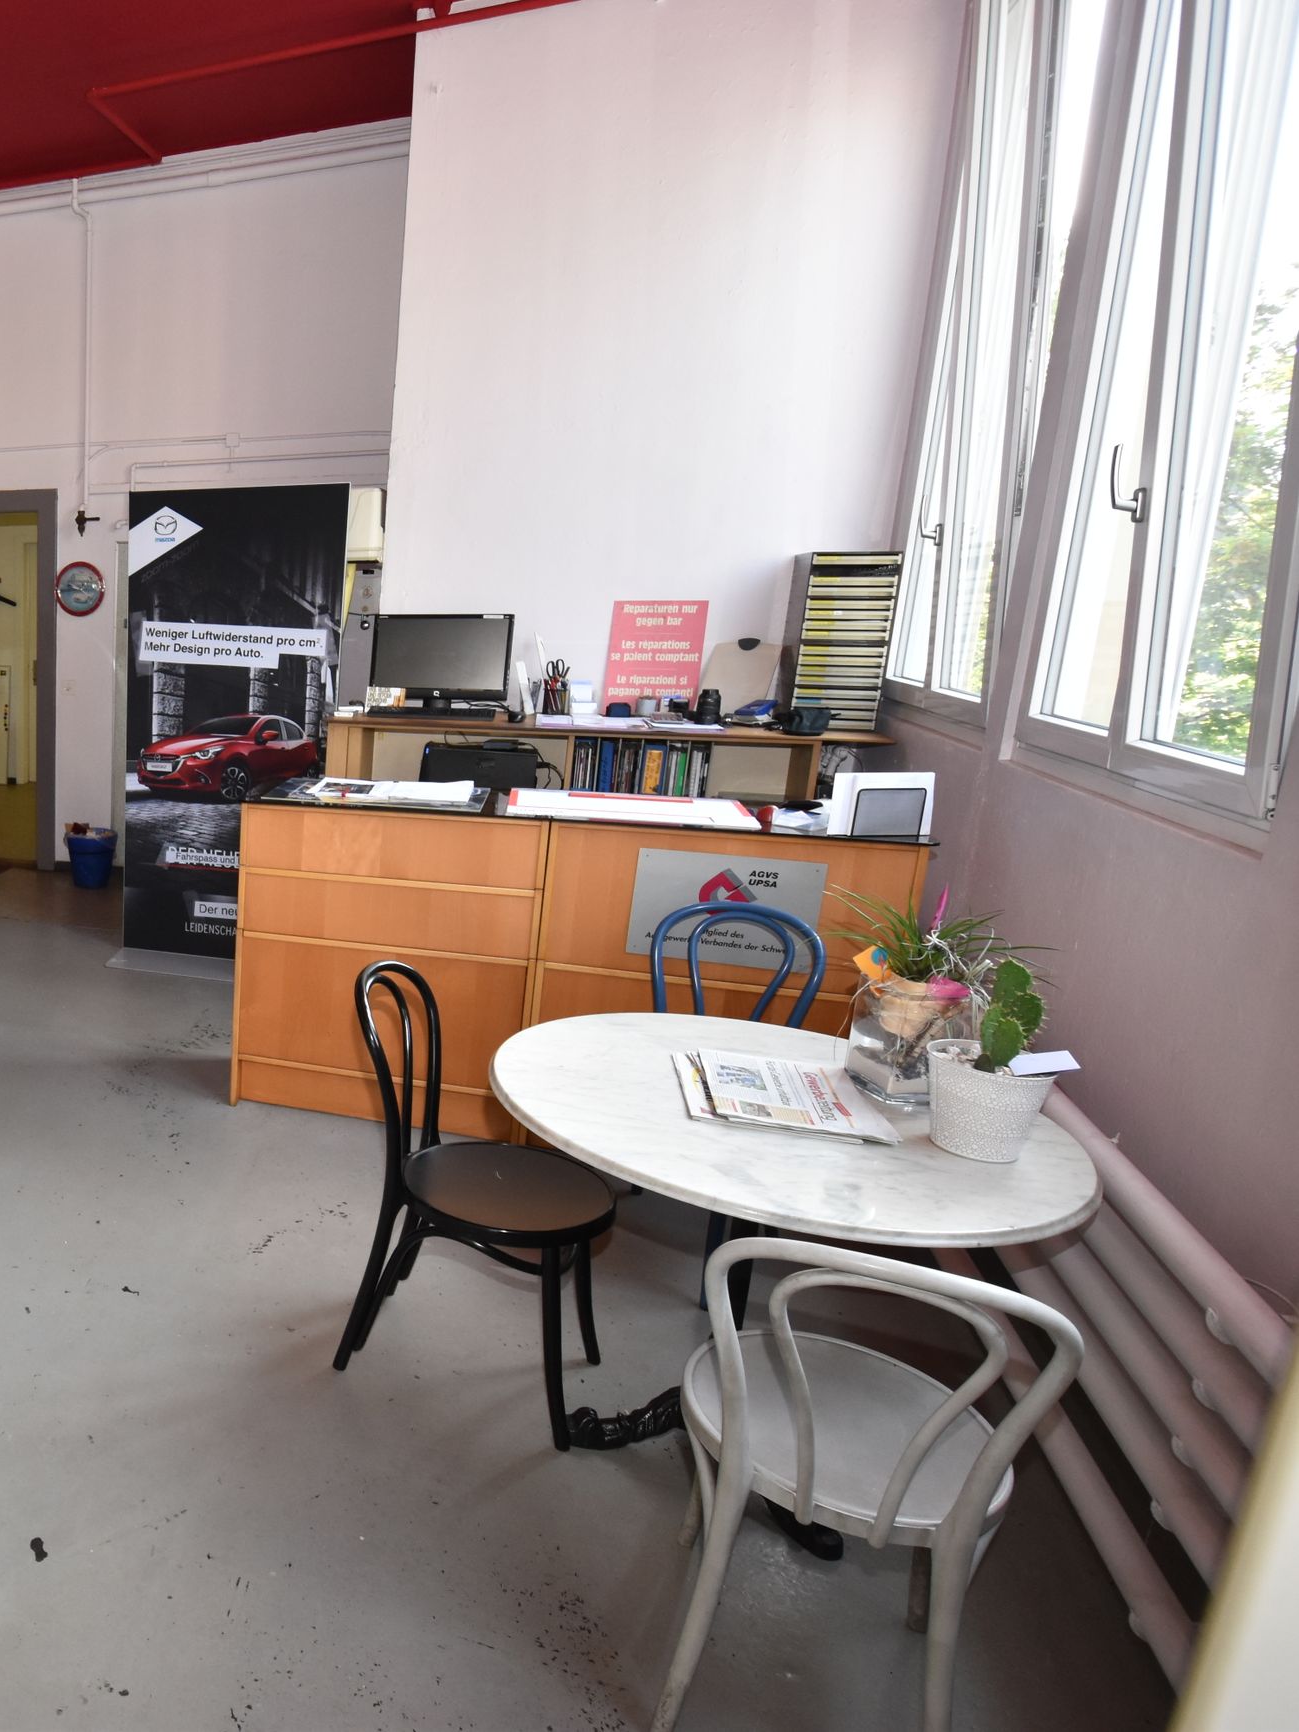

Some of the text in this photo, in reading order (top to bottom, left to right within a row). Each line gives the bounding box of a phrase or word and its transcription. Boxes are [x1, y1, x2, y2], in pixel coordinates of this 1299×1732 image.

[623, 604, 698, 615] Reparaturen nur
[636, 616, 683, 627] gegen bar
[145, 627, 188, 642] Weniger
[191, 630, 274, 645] Luftwiderstand
[276, 637, 296, 648] pro
[144, 641, 264, 659] Mehr Design pro Auto.
[621, 640, 690, 650] Les réparations
[611, 652, 699, 663] se paient comptant
[616, 675, 688, 686] Le riparazioni si
[608, 687, 694, 697] pagano in contanti
[176, 852, 235, 865] Fahrspass und
[749, 870, 779, 880] AGVS
[748, 879, 778, 889] UPSA
[199, 904, 218, 915] Der
[730, 930, 745, 939] des
[744, 942, 759, 951] der
